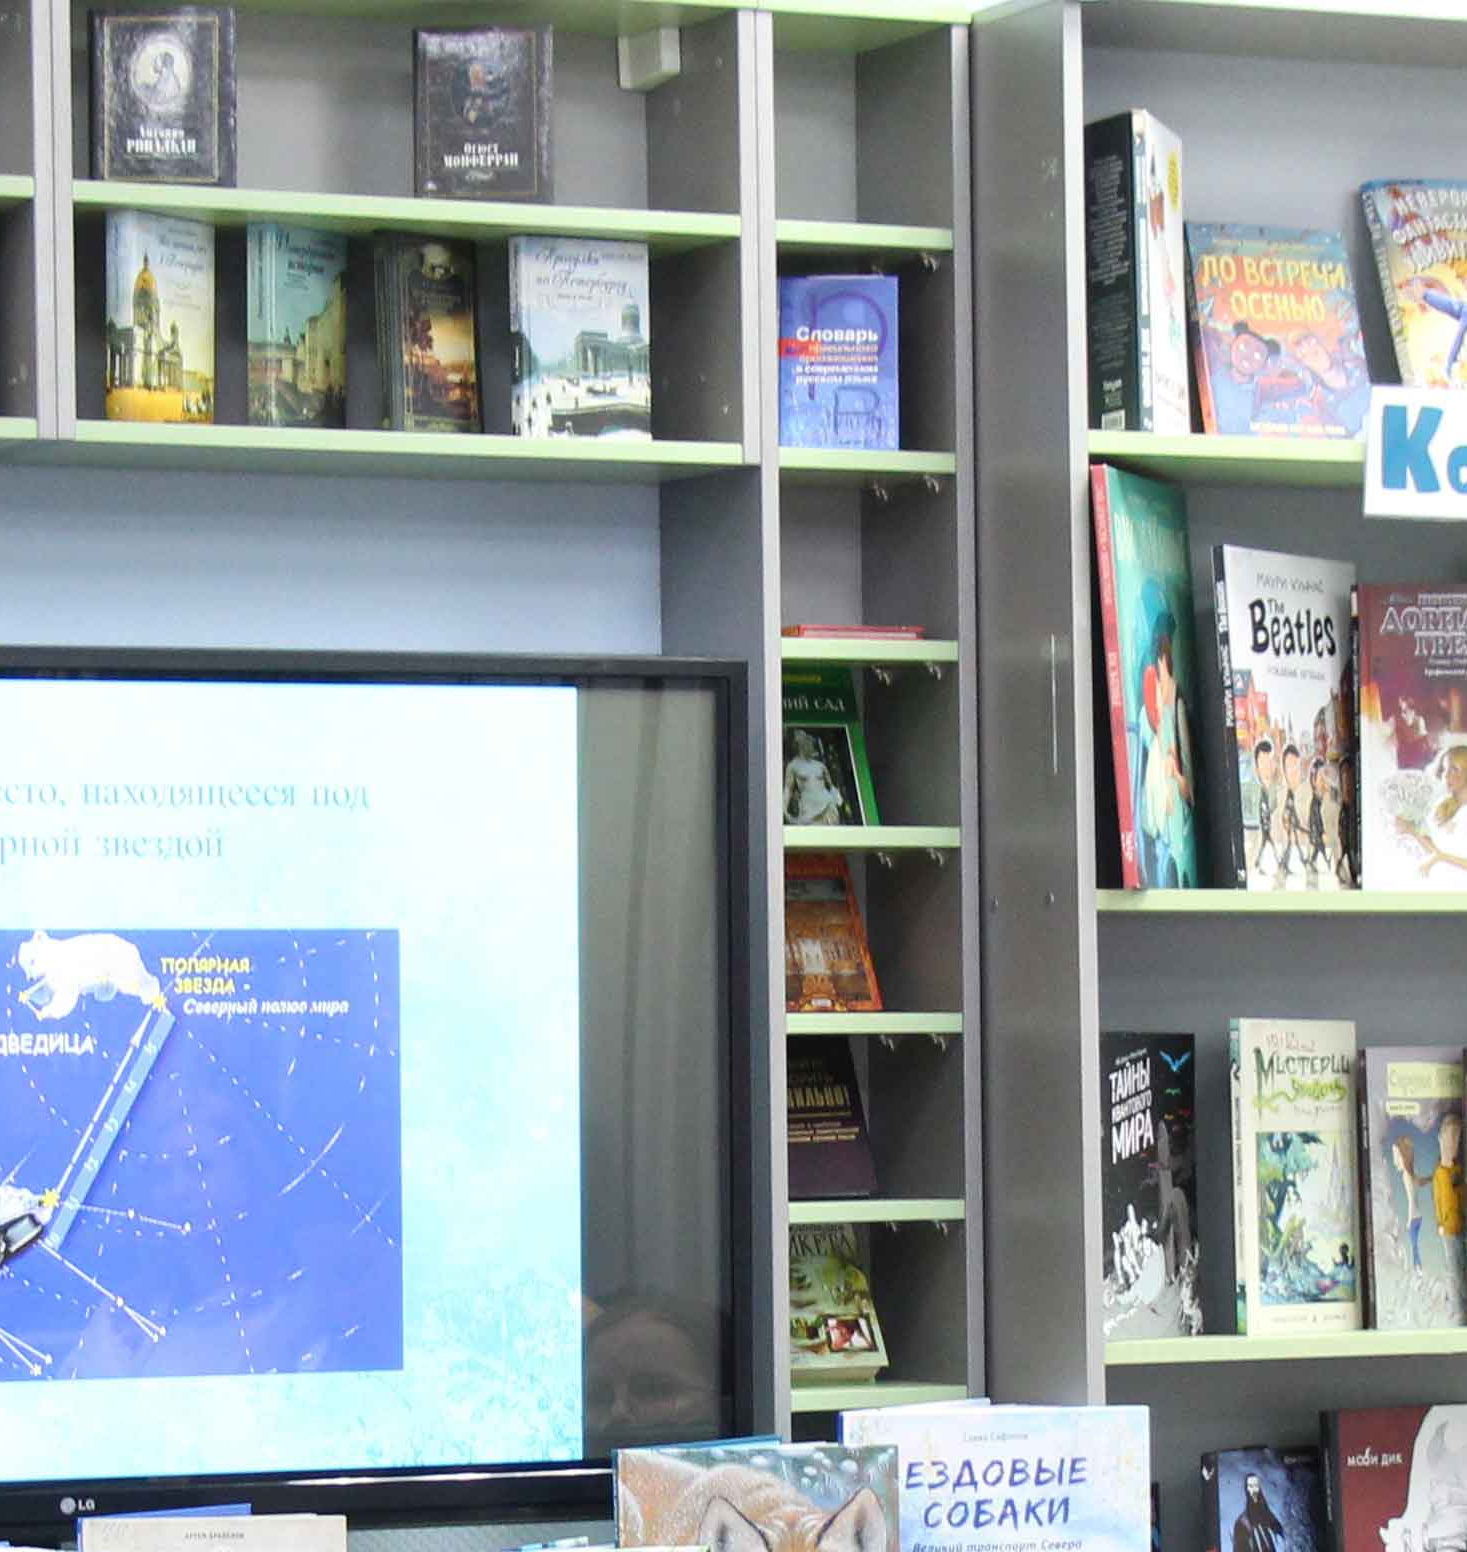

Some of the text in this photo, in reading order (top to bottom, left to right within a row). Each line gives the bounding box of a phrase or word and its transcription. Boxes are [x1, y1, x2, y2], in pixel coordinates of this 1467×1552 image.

[443, 153, 519, 169] МОНФЕРРАН
[1242, 256, 1347, 291] ВСТРЕЧИ
[1230, 290, 1327, 321] ОСЕНЬЮ
[796, 326, 879, 345] Словарь
[1267, 598, 1285, 613] The
[1249, 597, 1337, 658] Beatles
[81, 780, 296, 812] находящееся
[311, 781, 370, 813] под
[94, 829, 225, 861] звездой
[160, 956, 251, 974] ПОЛЯРНАЯ
[174, 978, 236, 995] ЗВЕЗДА
[1109, 1056, 1152, 1105] ТАЙНЫ
[1112, 1109, 1155, 1166] МИРА
[905, 1456, 1088, 1494] ЕЗДОВЫЕ
[1380, 1454, 1404, 1470] ДИК
[77, 1498, 96, 1512] LG
[923, 1496, 1071, 1531] СОБАКИ
[1040, 1538, 1083, 1552] Севера
